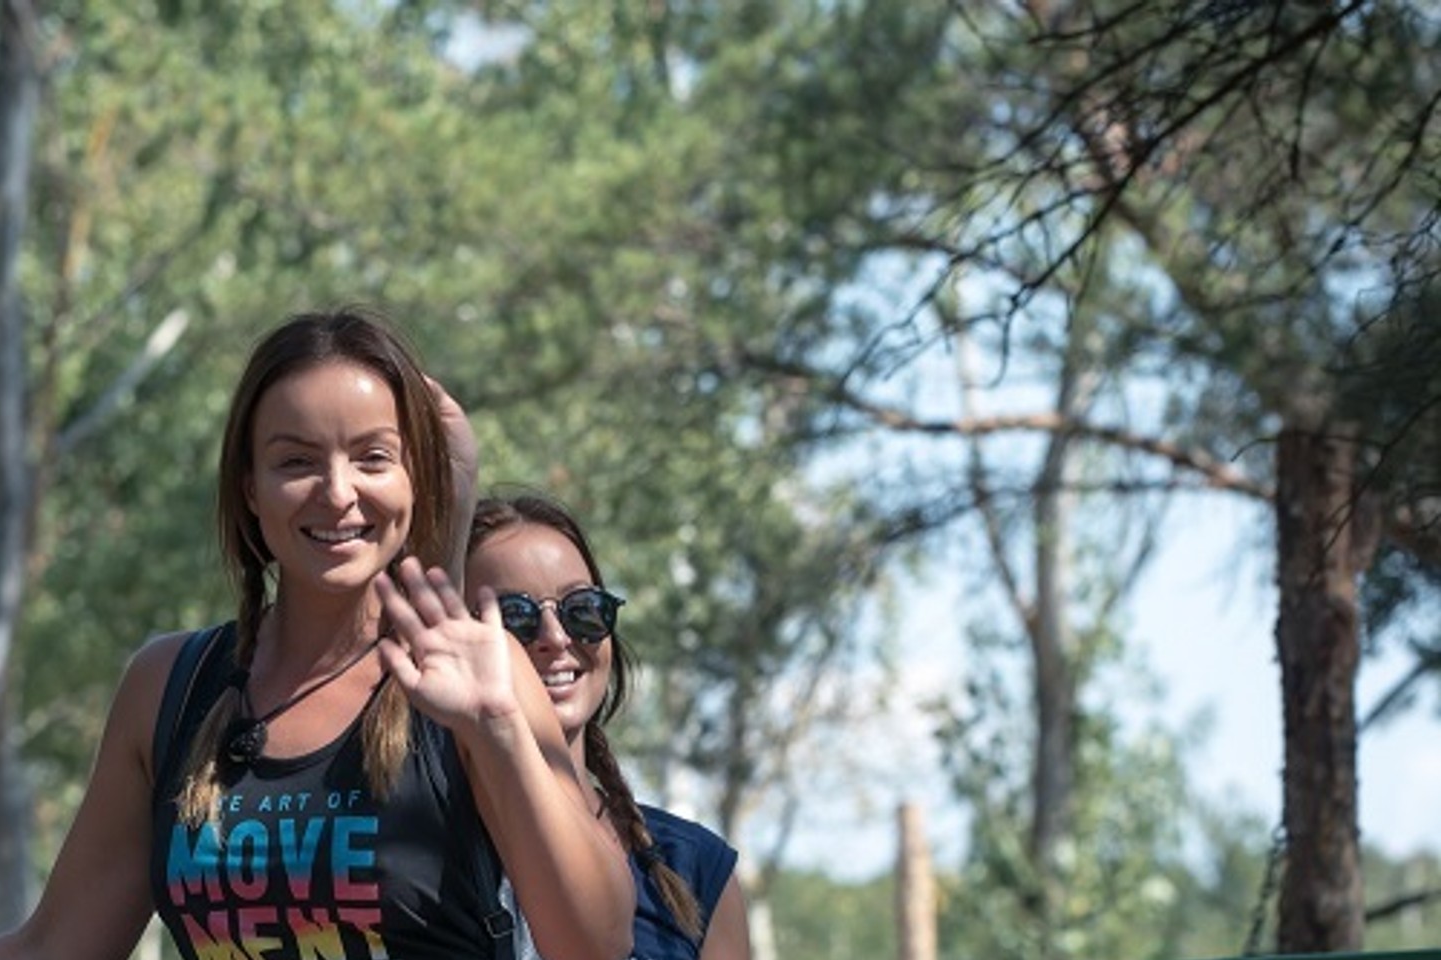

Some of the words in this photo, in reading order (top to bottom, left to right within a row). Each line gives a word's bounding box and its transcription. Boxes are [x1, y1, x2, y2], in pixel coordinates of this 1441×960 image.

[258, 792, 311, 812] ART
[327, 789, 361, 809] OF
[166, 815, 380, 906] MOVE
